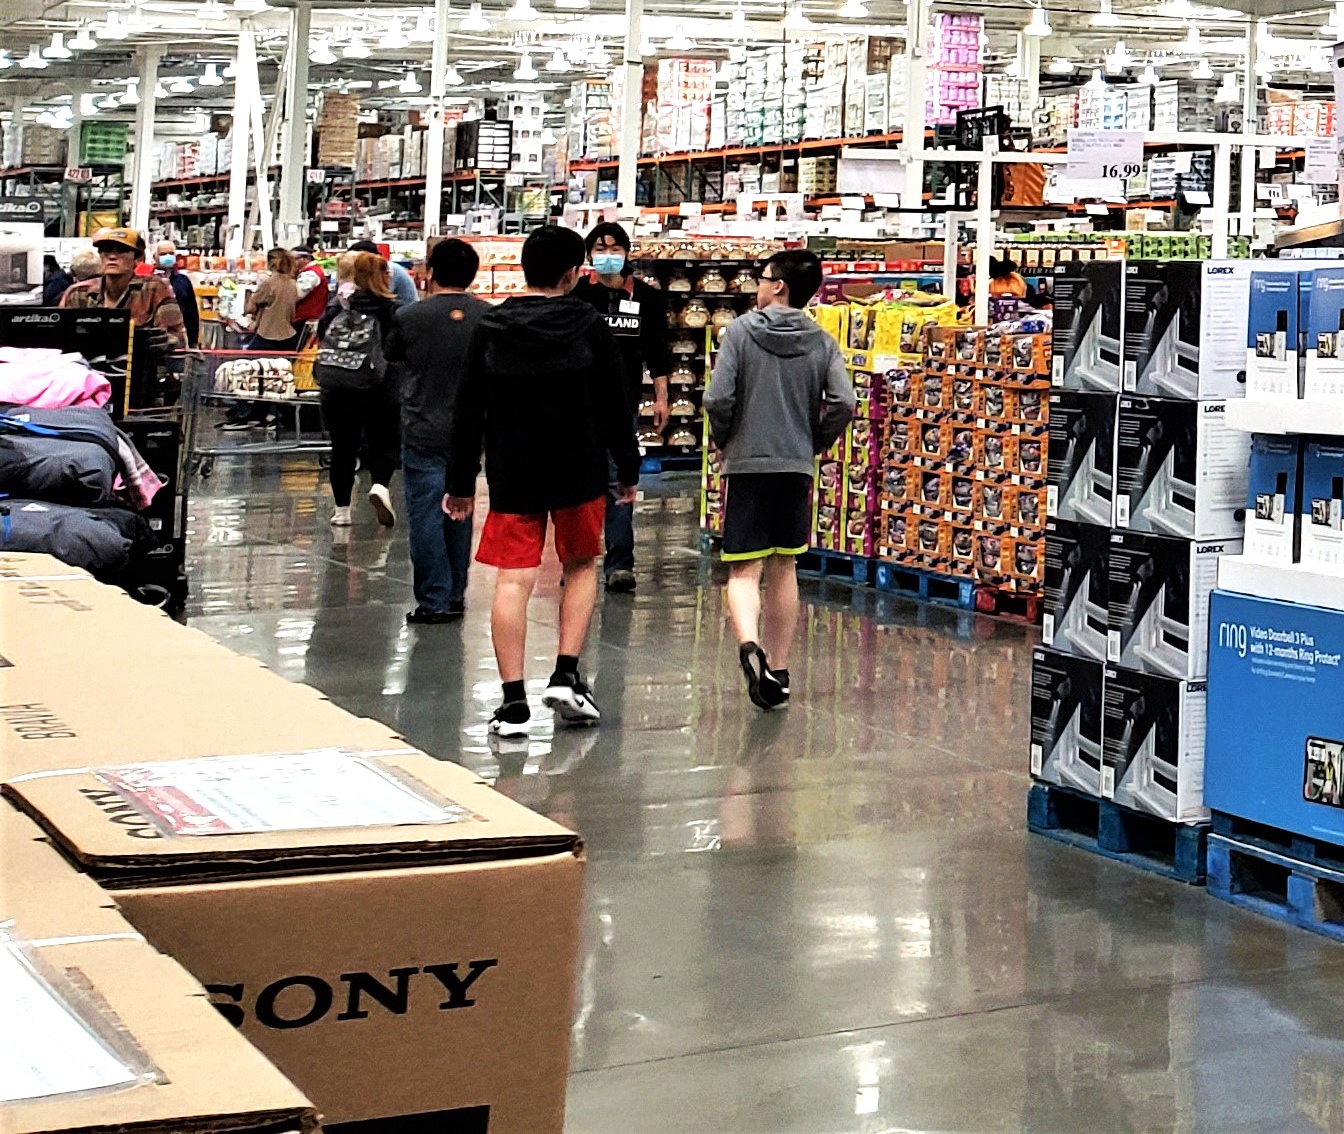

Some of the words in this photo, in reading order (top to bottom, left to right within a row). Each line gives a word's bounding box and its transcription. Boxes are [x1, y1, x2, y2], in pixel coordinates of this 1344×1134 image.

[1102, 165, 1140, 178] 16.99
[11, 314, 54, 322] artika
[605, 317, 639, 328] LAND
[1204, 405, 1226, 413] LORE
[1197, 545, 1224, 554] LOREX
[1219, 622, 1247, 657] ring
[1250, 626, 1268, 640] Video
[1269, 628, 1295, 644] Doorbell
[1301, 633, 1314, 646] Plus
[1250, 643, 1264, 654] with
[1265, 644, 1299, 660] 12-months
[1299, 648, 1314, 664] Ring
[202, 959, 498, 1029] SONY
